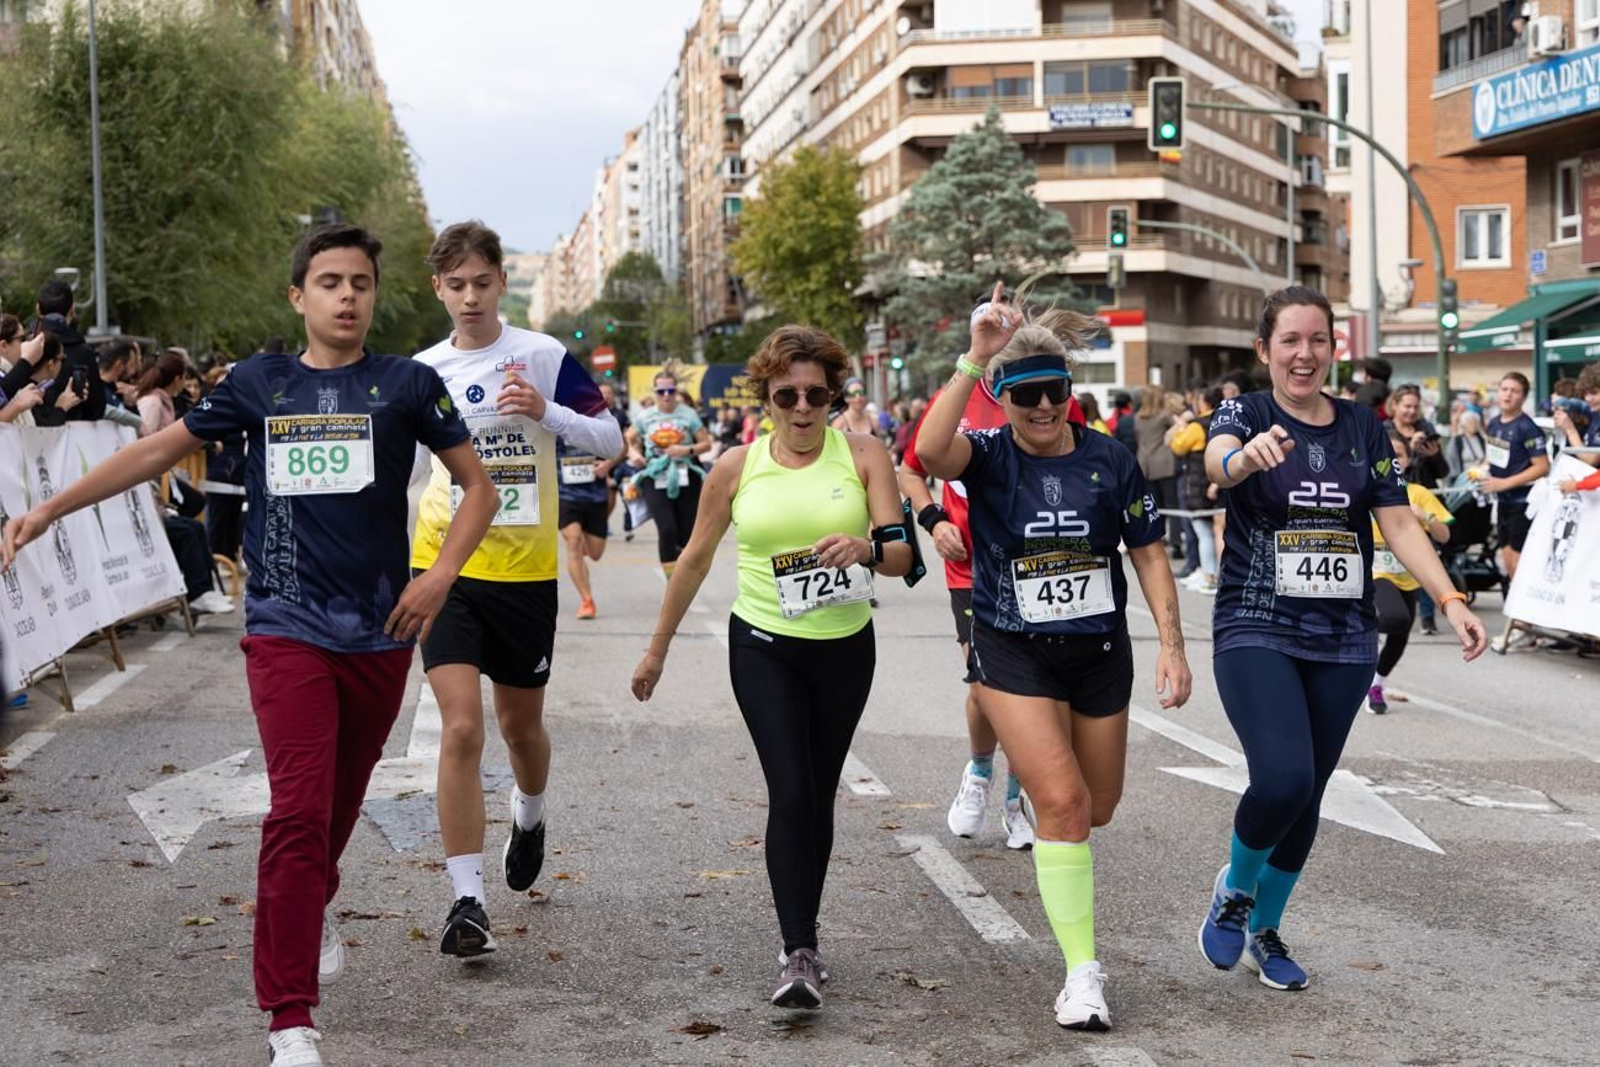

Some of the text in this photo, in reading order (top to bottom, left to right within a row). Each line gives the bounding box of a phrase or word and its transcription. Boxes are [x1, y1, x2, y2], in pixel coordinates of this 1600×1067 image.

[1496, 70, 1558, 110] CLÍNICA
[271, 420, 291, 435] XXV
[292, 419, 327, 427] CARRERA
[300, 425, 322, 433] gran
[326, 423, 367, 432] caminata
[478, 424, 524, 435] RUNNING
[507, 433, 526, 443] DE
[288, 445, 350, 476] 869
[1288, 481, 1350, 508] 25
[1024, 510, 1090, 538] 25
[1280, 534, 1300, 546] XXV
[774, 555, 794, 569] XXV
[1047, 560, 1067, 569] gran
[1383, 553, 1393, 566] 9
[1296, 556, 1348, 582] 446
[793, 569, 852, 601] 724
[1037, 575, 1091, 606] 437
